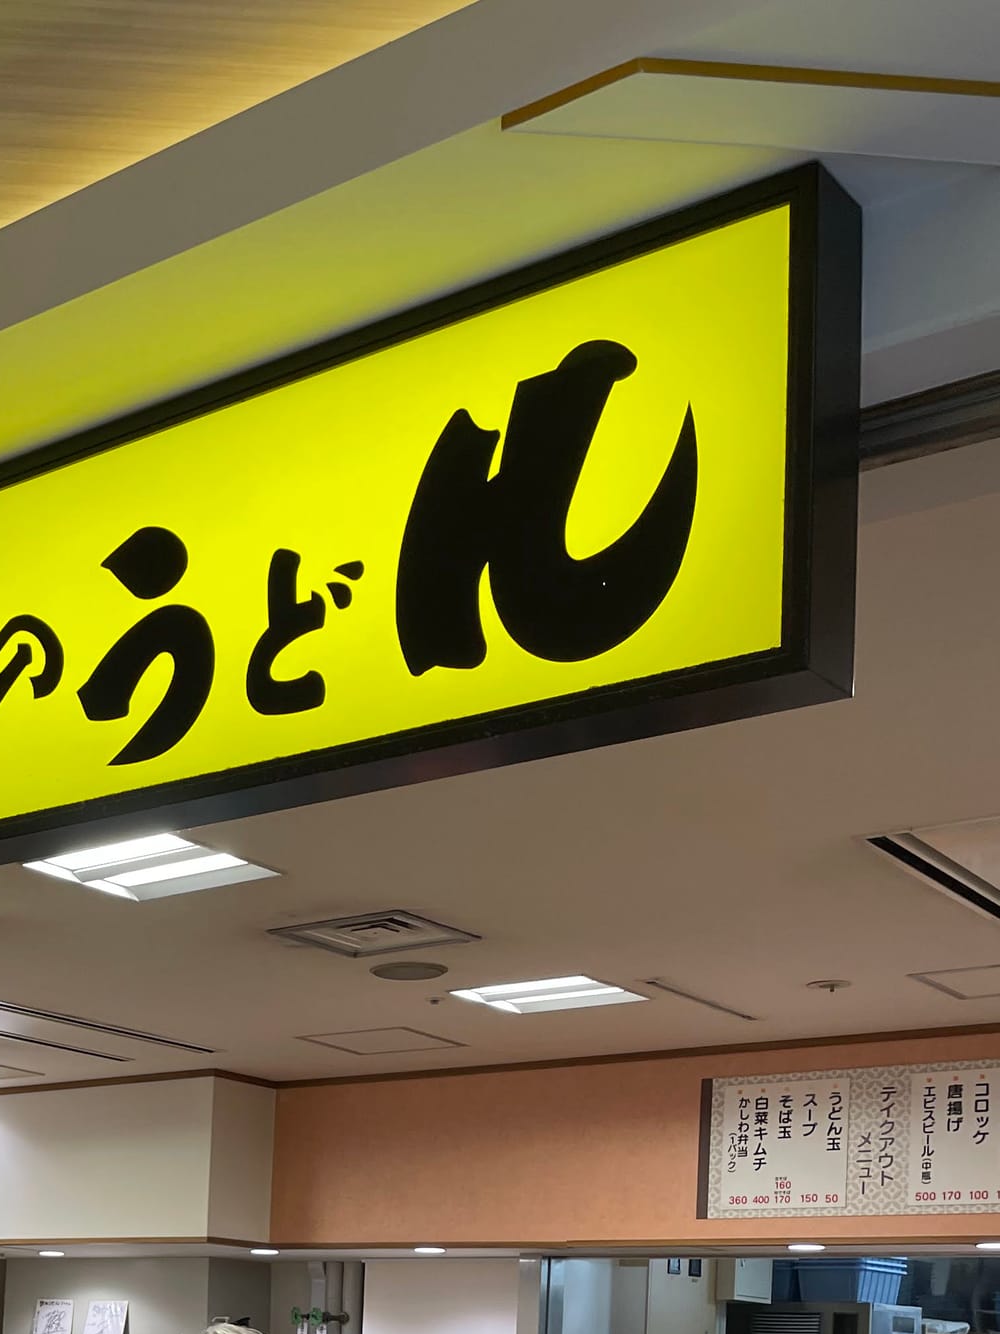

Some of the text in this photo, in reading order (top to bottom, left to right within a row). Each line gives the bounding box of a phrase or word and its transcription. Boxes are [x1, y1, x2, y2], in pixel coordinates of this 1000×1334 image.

[737, 1097, 751, 1158] かしわ弁当
[753, 1096, 769, 1172] 白菜キムチ
[778, 1095, 794, 1139] そば玉
[802, 1093, 818, 1137] スープ
[826, 1091, 843, 1152] うどん玉
[947, 1084, 964, 1132] 唐揚げ
[973, 1083, 990, 1145] コロッケ
[856, 1132, 873, 1195] メニュー
[878, 1086, 897, 1187] テイクアウト
[728, 1194, 838, 1205] 360 400 170 150 50
[775, 1181, 791, 1190] 160
[915, 1191, 937, 1201] 500
[942, 1190, 961, 1200] 170
[969, 1190, 989, 1200] 100
